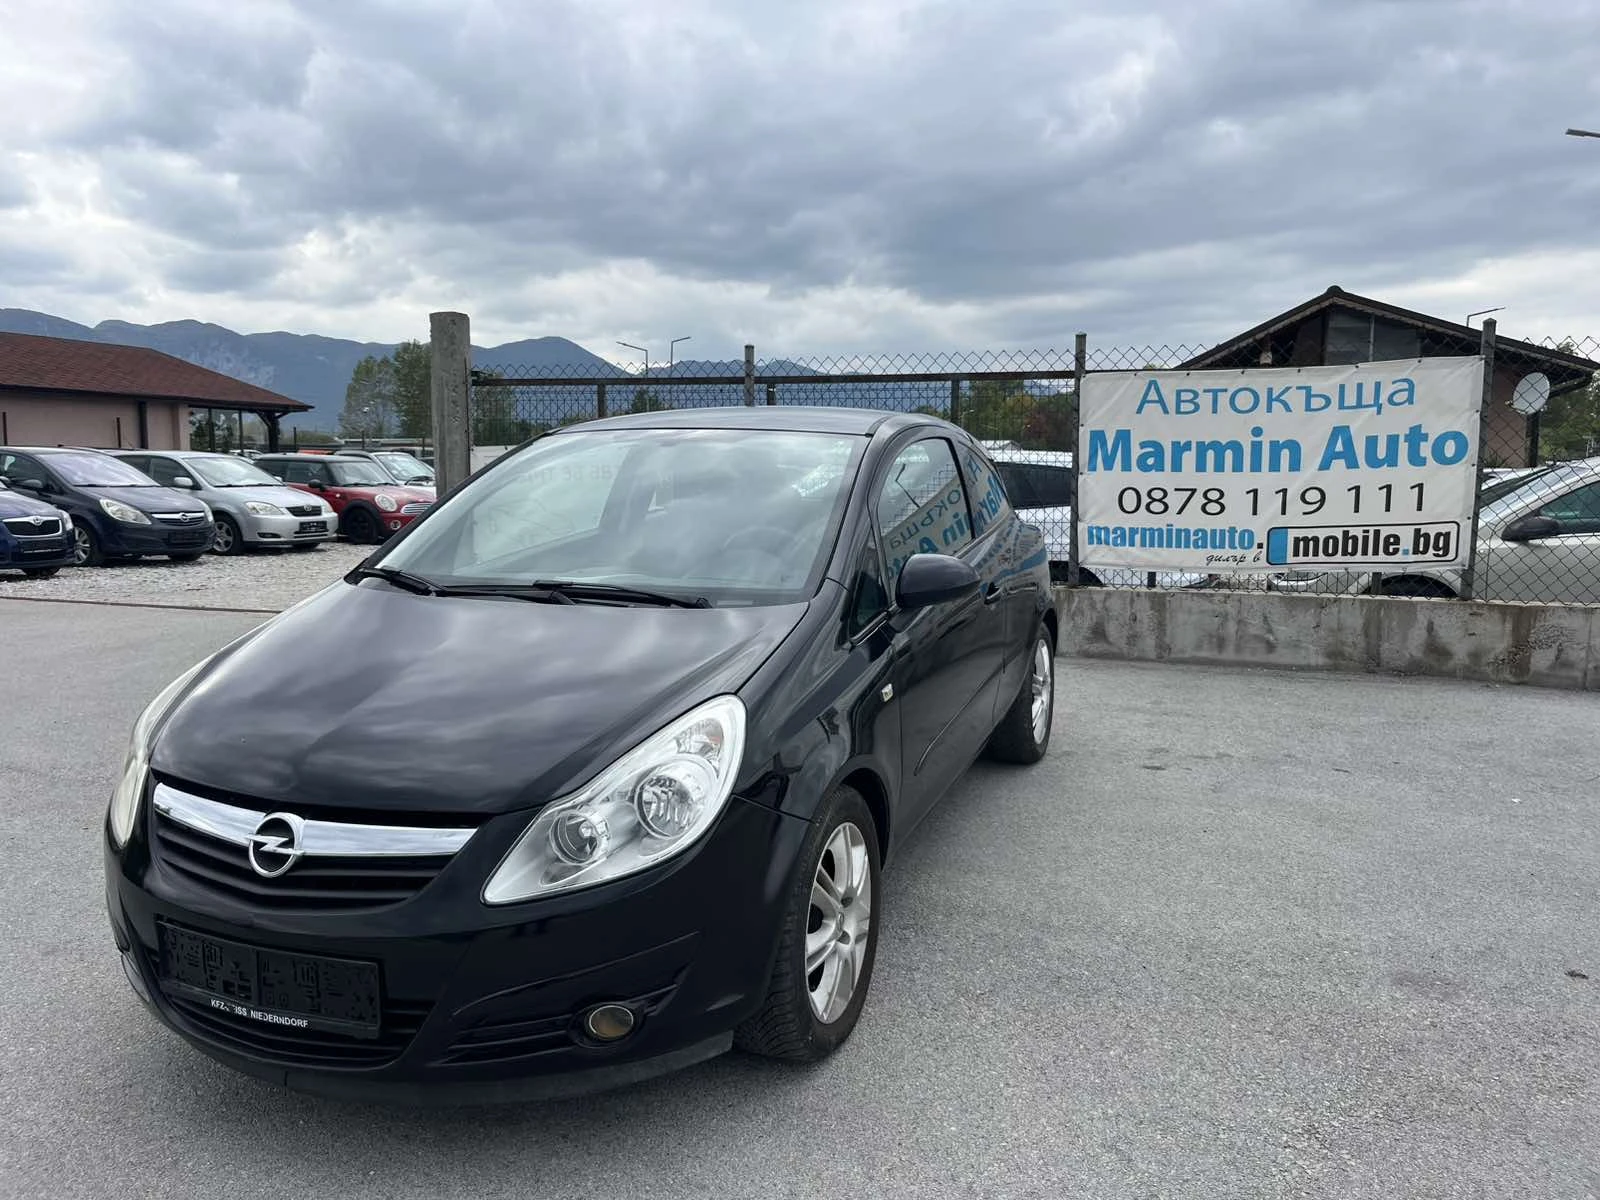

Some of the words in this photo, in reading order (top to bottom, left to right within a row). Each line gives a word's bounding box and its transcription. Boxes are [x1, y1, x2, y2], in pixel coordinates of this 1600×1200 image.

[1135, 376, 1416, 415] Автокъща
[1087, 426, 1301, 473] Marmin
[1318, 423, 1469, 471] Auto
[1117, 486, 1226, 516] 0878
[1245, 486, 1327, 516] 119
[1347, 482, 1425, 513] 111
[1292, 527, 1452, 557] mobile.bg
[250, 1010, 309, 1028] NIEDERNDORF
